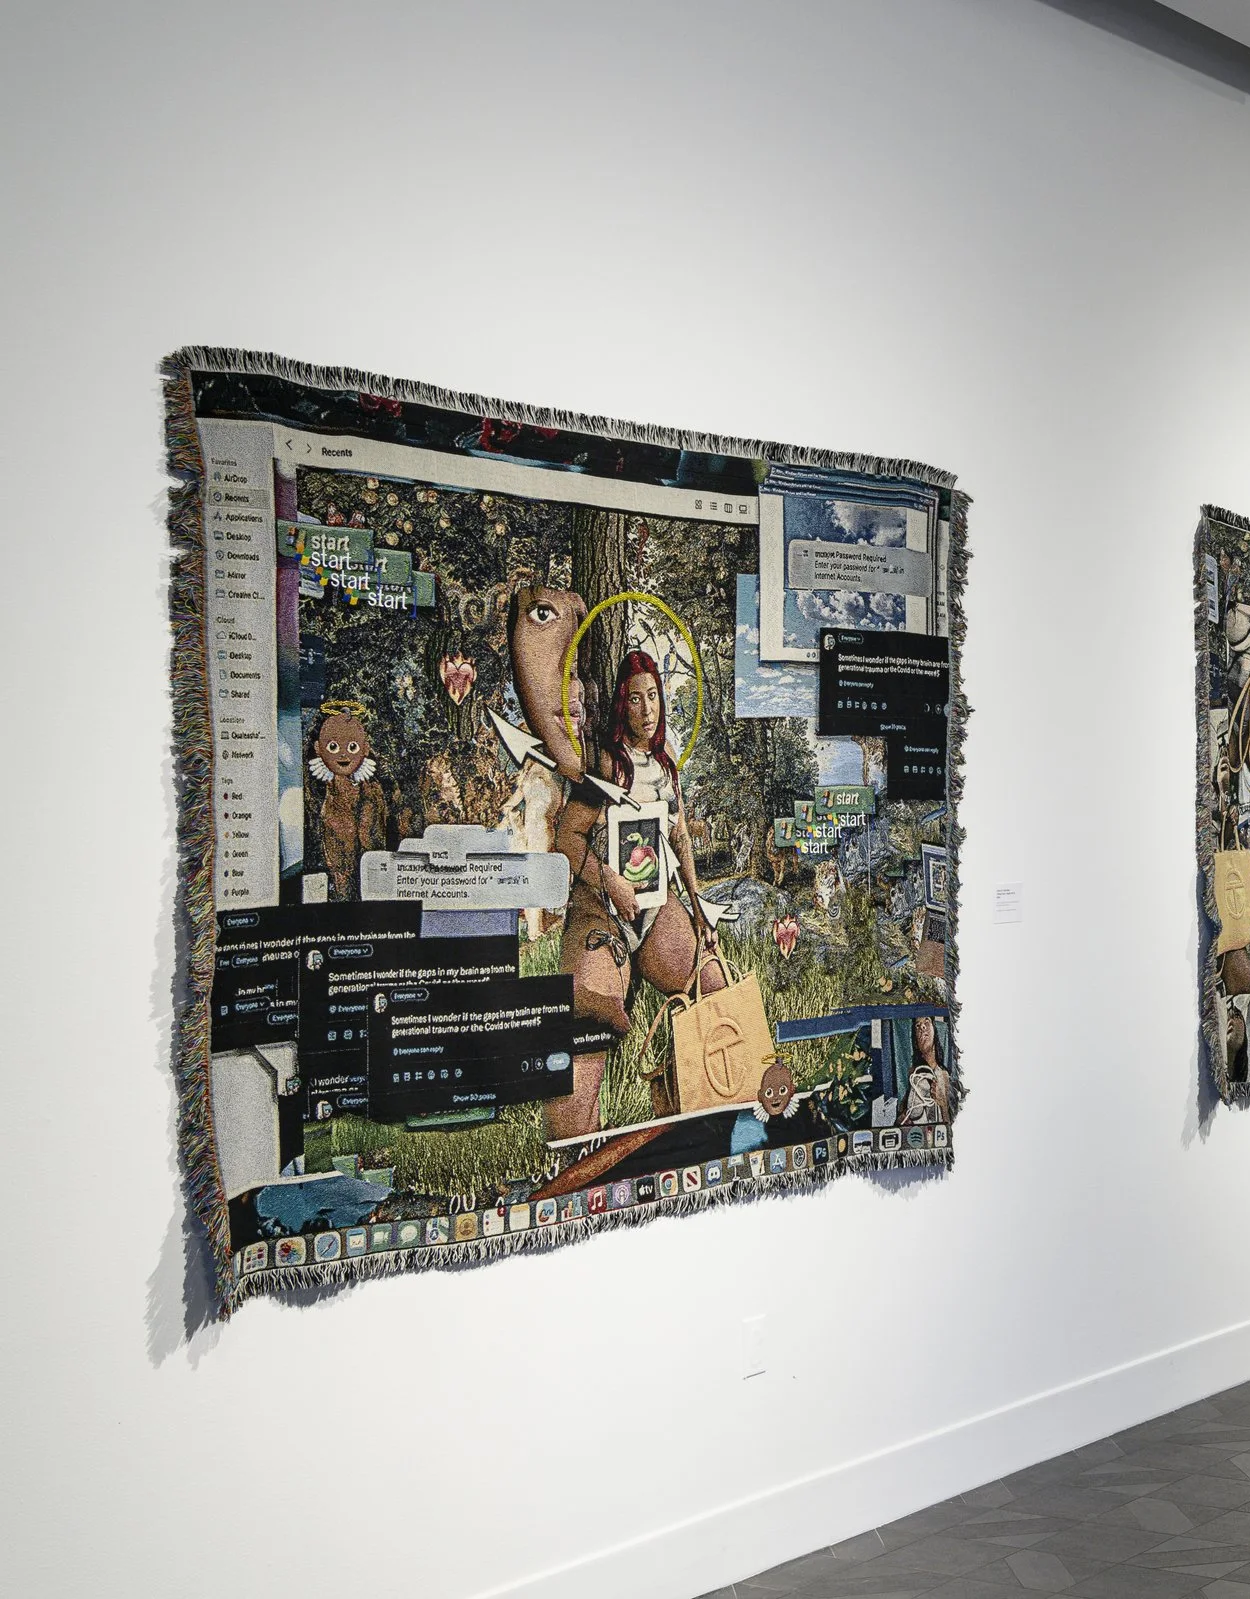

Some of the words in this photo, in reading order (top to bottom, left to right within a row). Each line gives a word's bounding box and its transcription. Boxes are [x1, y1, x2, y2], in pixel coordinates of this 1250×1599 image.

[321, 446, 353, 458] Recents
[224, 474, 248, 484] AirDrop
[224, 492, 250, 503] Recents
[225, 513, 263, 524] Applications
[226, 532, 251, 542] Desktop
[311, 533, 350, 551] start
[227, 551, 260, 561] Downloads
[311, 548, 352, 571] start
[836, 551, 862, 561] Password
[862, 553, 887, 563] Required
[815, 561, 829, 569] Enter
[829, 562, 842, 571] your
[843, 563, 868, 573] password
[330, 570, 371, 590] start
[814, 572, 836, 581] Internet
[368, 588, 408, 610] start
[865, 655, 884, 665] wonder
[230, 670, 261, 680] Documents
[897, 666, 911, 674] Covid
[230, 689, 250, 699] Shared
[231, 792, 243, 800] Red
[836, 791, 860, 805] start
[232, 812, 252, 821] Orange
[840, 810, 866, 827] start
[232, 831, 249, 839] Yellow
[815, 822, 842, 839] start
[801, 838, 828, 854] start
[232, 850, 249, 858] Green
[469, 862, 503, 874] Required
[396, 876, 418, 885] Enter
[420, 877, 438, 886] your
[440, 876, 476, 887] password
[478, 876, 488, 885] for
[522, 876, 529, 885] in
[231, 888, 250, 898] Purple
[396, 889, 429, 899] Internet
[430, 889, 470, 899] Accounts.
[262, 938, 294, 948] wonder
[337, 933, 344, 942] in
[328, 970, 372, 982] Sometimes
[376, 968, 399, 979] wonder
[399, 968, 405, 978] if
[405, 968, 417, 978] the
[417, 967, 437, 979] gaps
[437, 967, 445, 977] in
[446, 967, 459, 978] my
[459, 966, 480, 976] brain
[480, 967, 490, 975] are
[490, 964, 504, 974] from
[504, 963, 516, 973] the
[391, 1013, 427, 1025] Sometimes
[432, 1012, 461, 1023] wonder
[462, 1011, 468, 1021] if
[469, 1011, 482, 1022] the
[482, 1011, 499, 1022] gaps
[499, 1009, 505, 1018] in
[505, 1009, 516, 1019] my
[515, 1006, 531, 1017] brain
[531, 1006, 542, 1015] are
[542, 1004, 558, 1014] from
[558, 1003, 570, 1012] the
[391, 1025, 431, 1039] generational
[431, 1025, 459, 1035] trauma
[460, 1025, 469, 1034] or
[470, 1023, 484, 1033] the
[484, 1021, 503, 1032] Covid
[503, 1022, 511, 1030] or
[317, 1074, 349, 1087] wonder
[936, 1130, 945, 1141] Ps
[815, 1147, 827, 1160] Ps
[644, 1185, 653, 1195] tv
